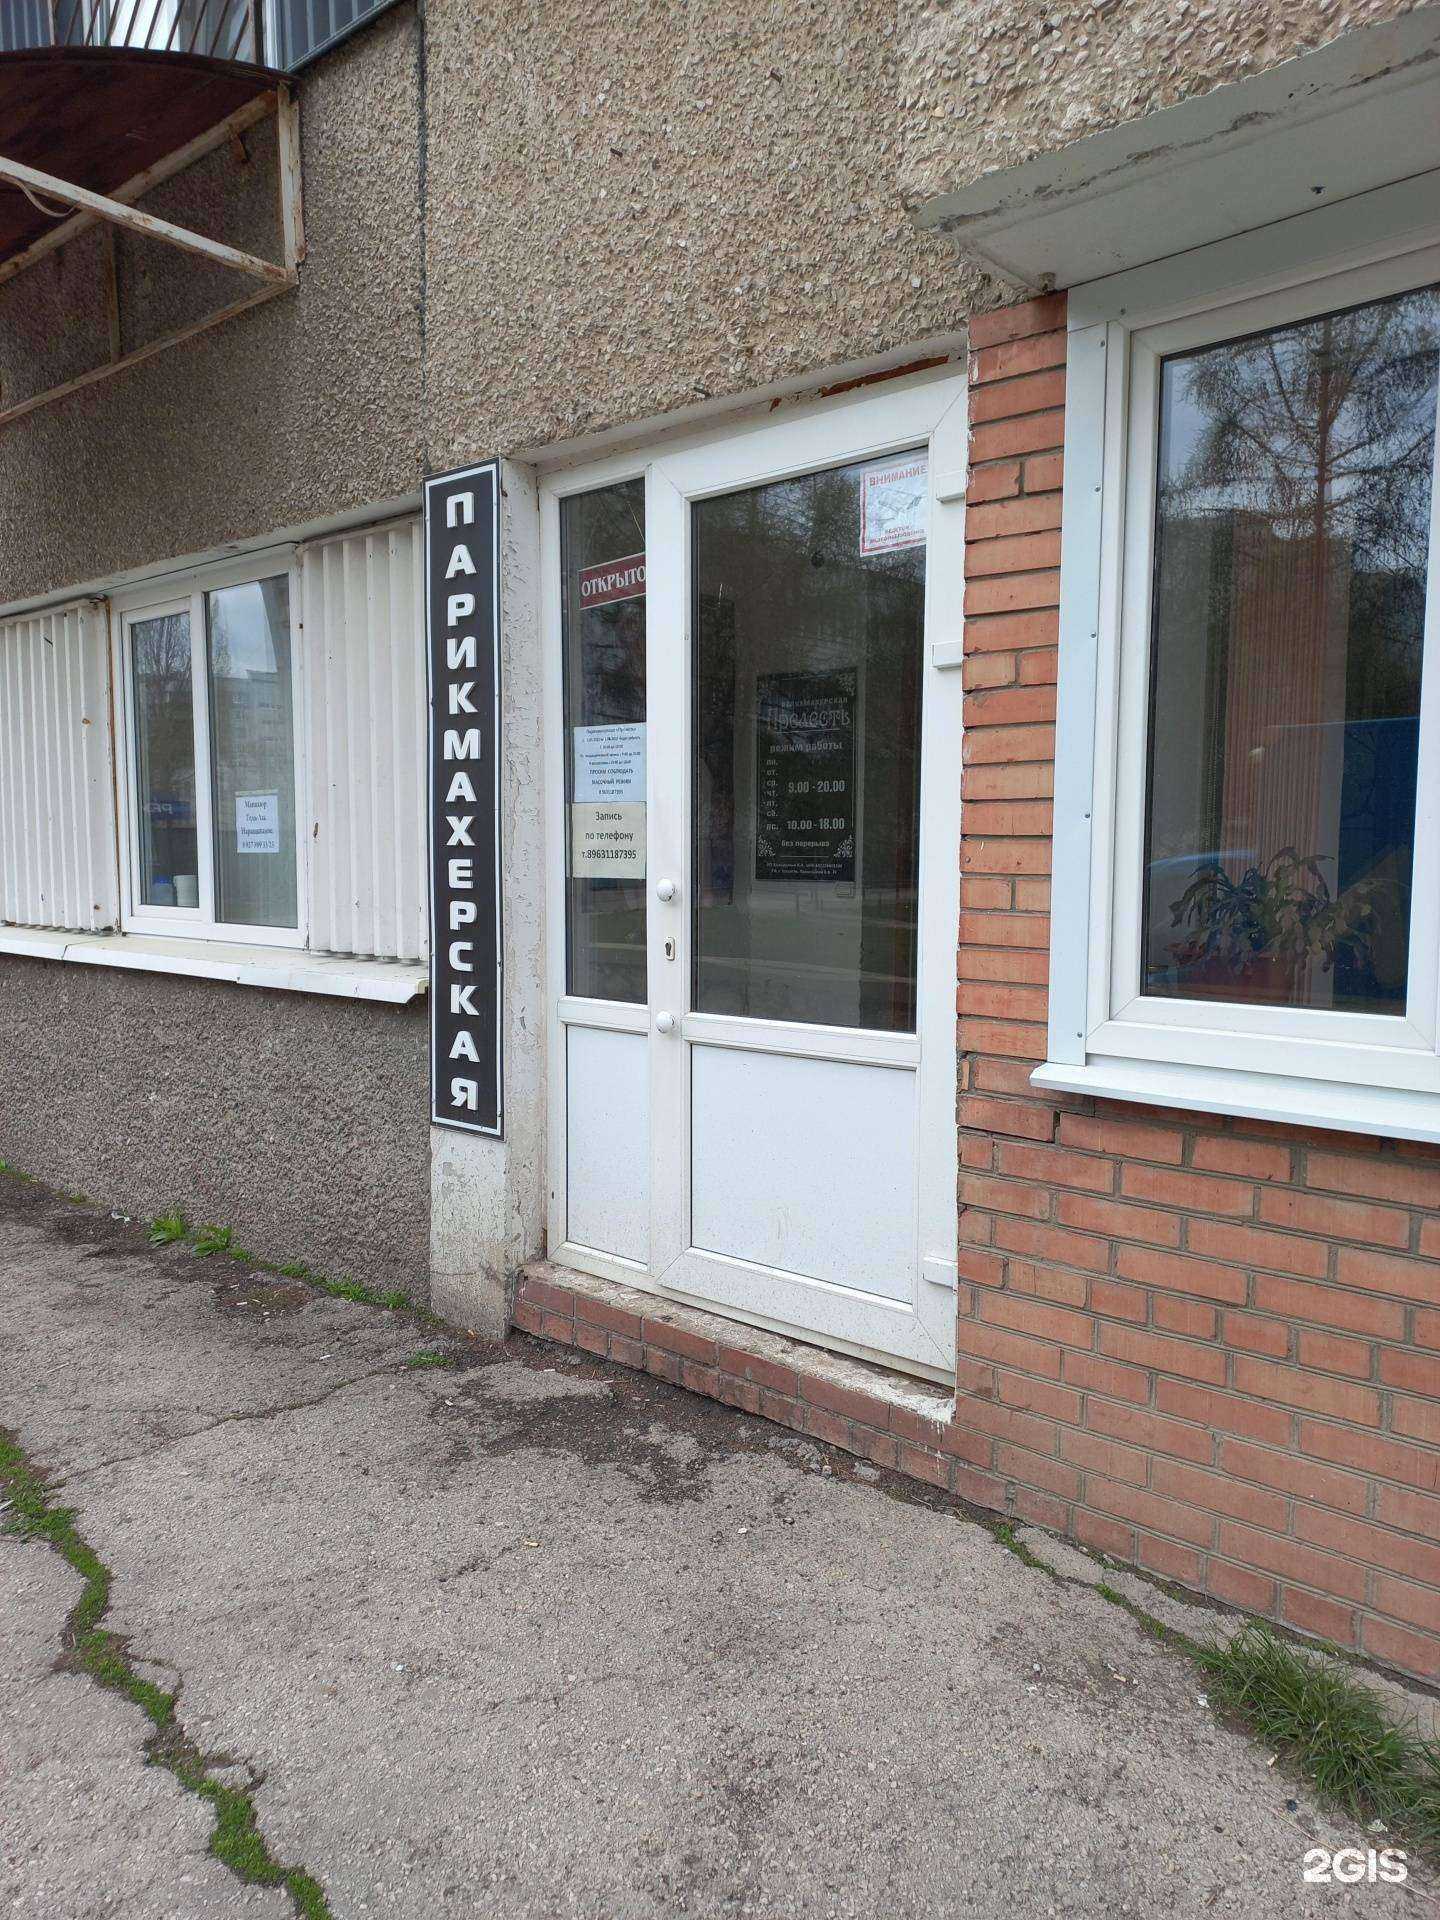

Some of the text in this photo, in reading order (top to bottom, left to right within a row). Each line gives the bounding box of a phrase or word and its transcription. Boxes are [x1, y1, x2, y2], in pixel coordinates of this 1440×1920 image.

[869, 465, 929, 487] ВНИМАНИЕ
[581, 565, 646, 598] ОТКРЫТО
[805, 737, 843, 752] работы
[443, 492, 482, 1112] ПАРИКМАХЕРСКАЯ
[595, 811, 623, 821] Запись
[585, 830, 634, 843] по телефону
